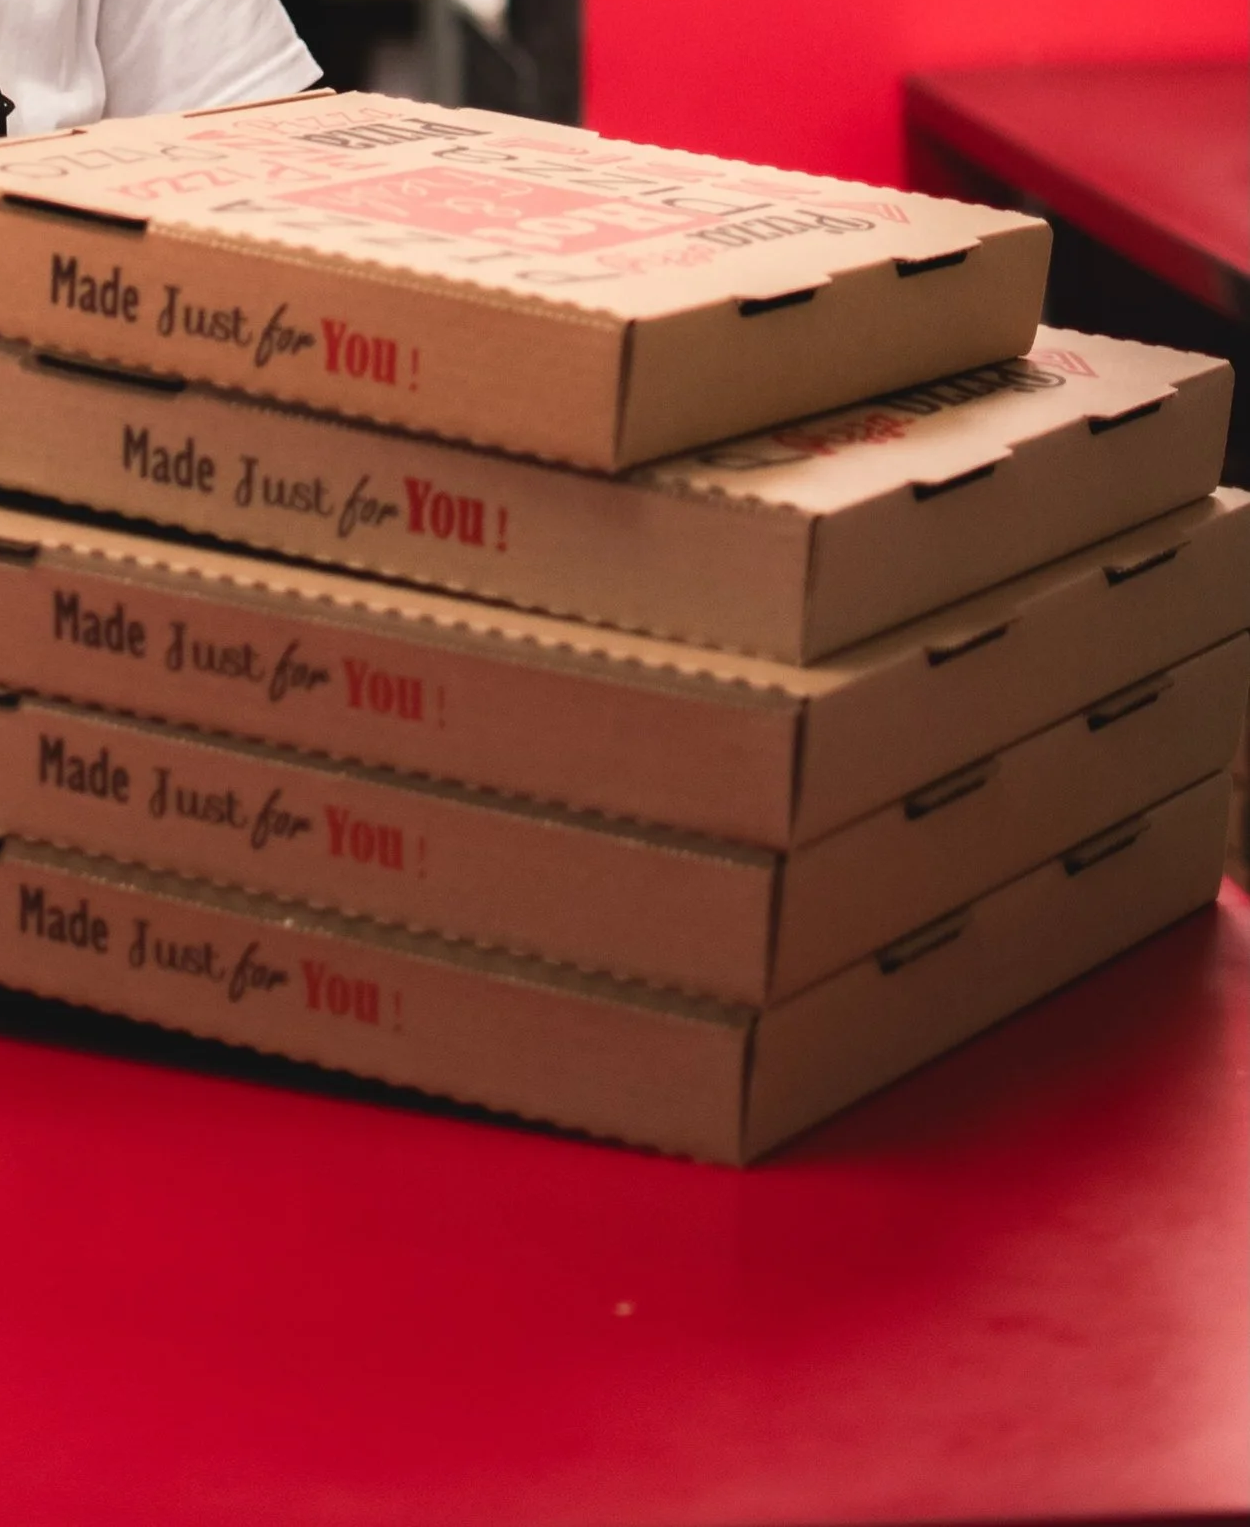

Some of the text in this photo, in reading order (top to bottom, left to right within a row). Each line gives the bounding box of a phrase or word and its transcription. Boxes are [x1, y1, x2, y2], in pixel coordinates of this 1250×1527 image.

[686, 210, 876, 247] Pizza
[50, 253, 140, 322] Made
[157, 285, 253, 348] Just
[254, 303, 315, 367] for
[123, 424, 216, 493] Made
[234, 456, 335, 517] Just
[337, 473, 399, 538] for
[53, 589, 146, 659] Made
[165, 621, 266, 683] Just
[269, 640, 330, 702] for
[38, 733, 129, 804] Made
[148, 767, 248, 830] Just
[250, 788, 313, 850] for
[18, 883, 108, 955] Made
[128, 919, 225, 982] Just
[228, 942, 289, 1003] for
